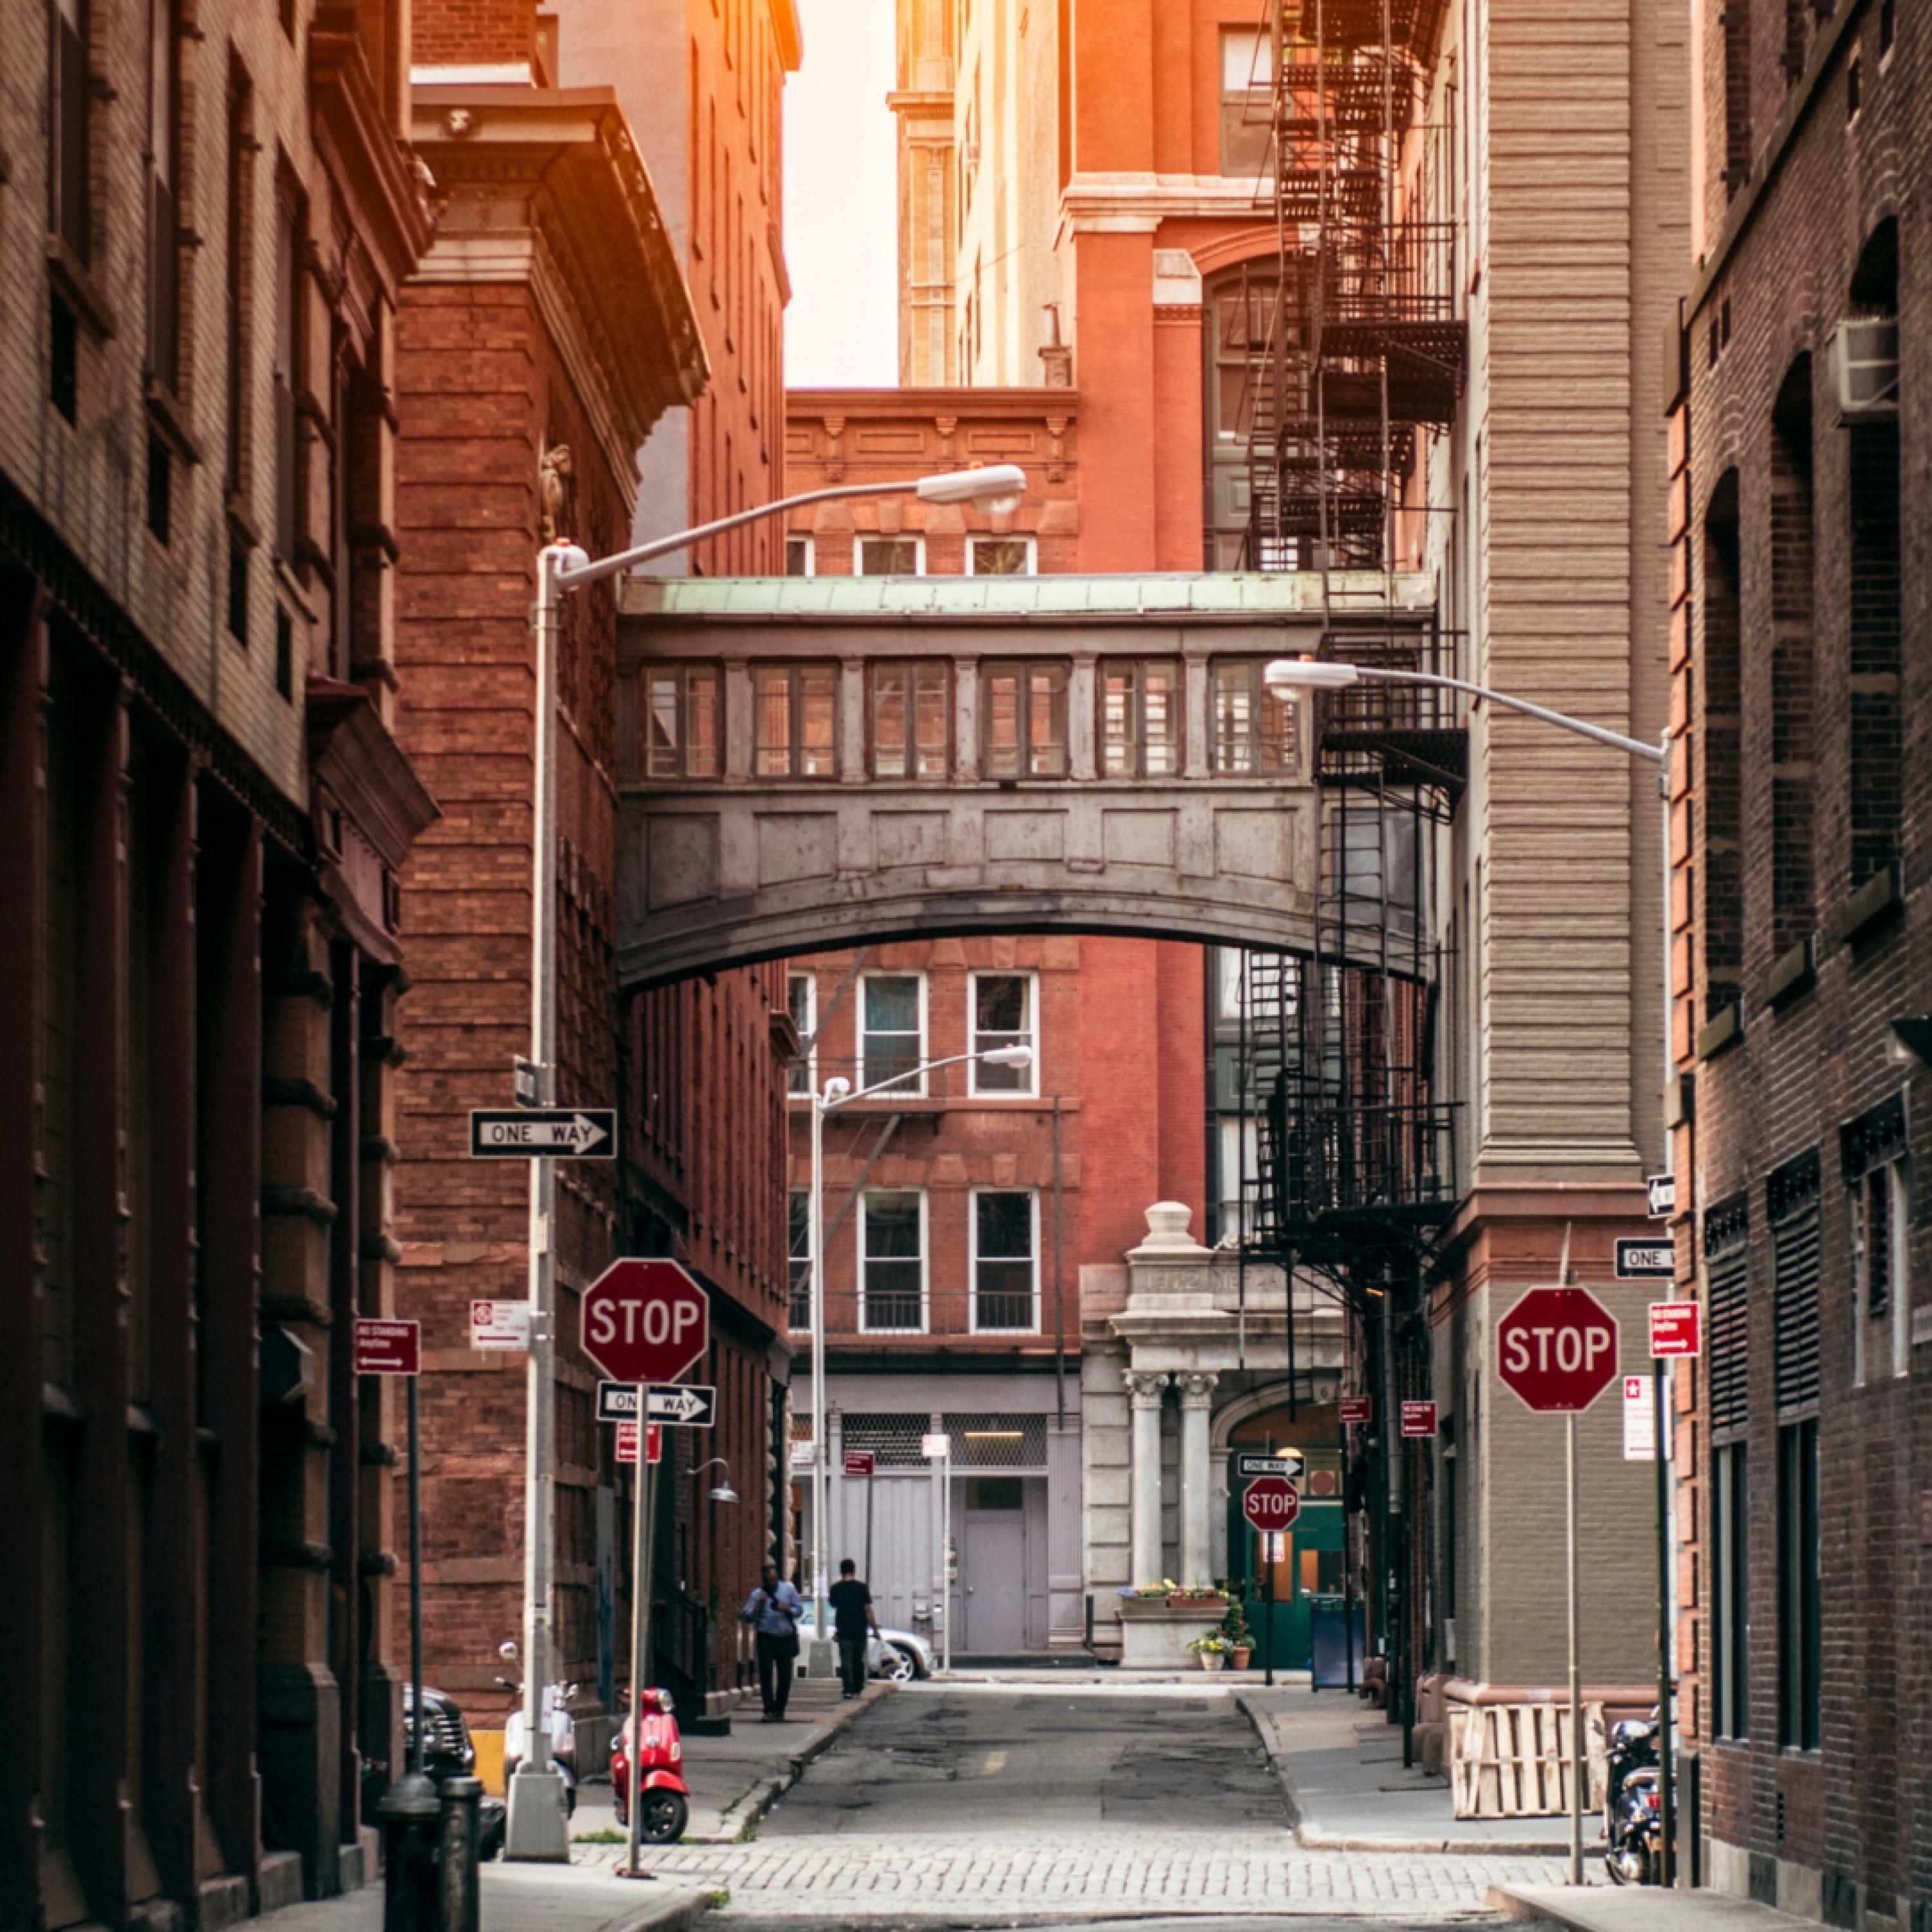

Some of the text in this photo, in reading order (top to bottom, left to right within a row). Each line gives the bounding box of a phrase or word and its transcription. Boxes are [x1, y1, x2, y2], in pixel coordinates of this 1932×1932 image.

[491, 1124, 593, 1142] ONE WAY
[1629, 1251, 1661, 1265] ONE
[590, 1298, 699, 1345] STOP
[1504, 1326, 1610, 1373] STOP
[615, 1394, 696, 1412] ON WAY
[1248, 1493, 1296, 1514] STOP
